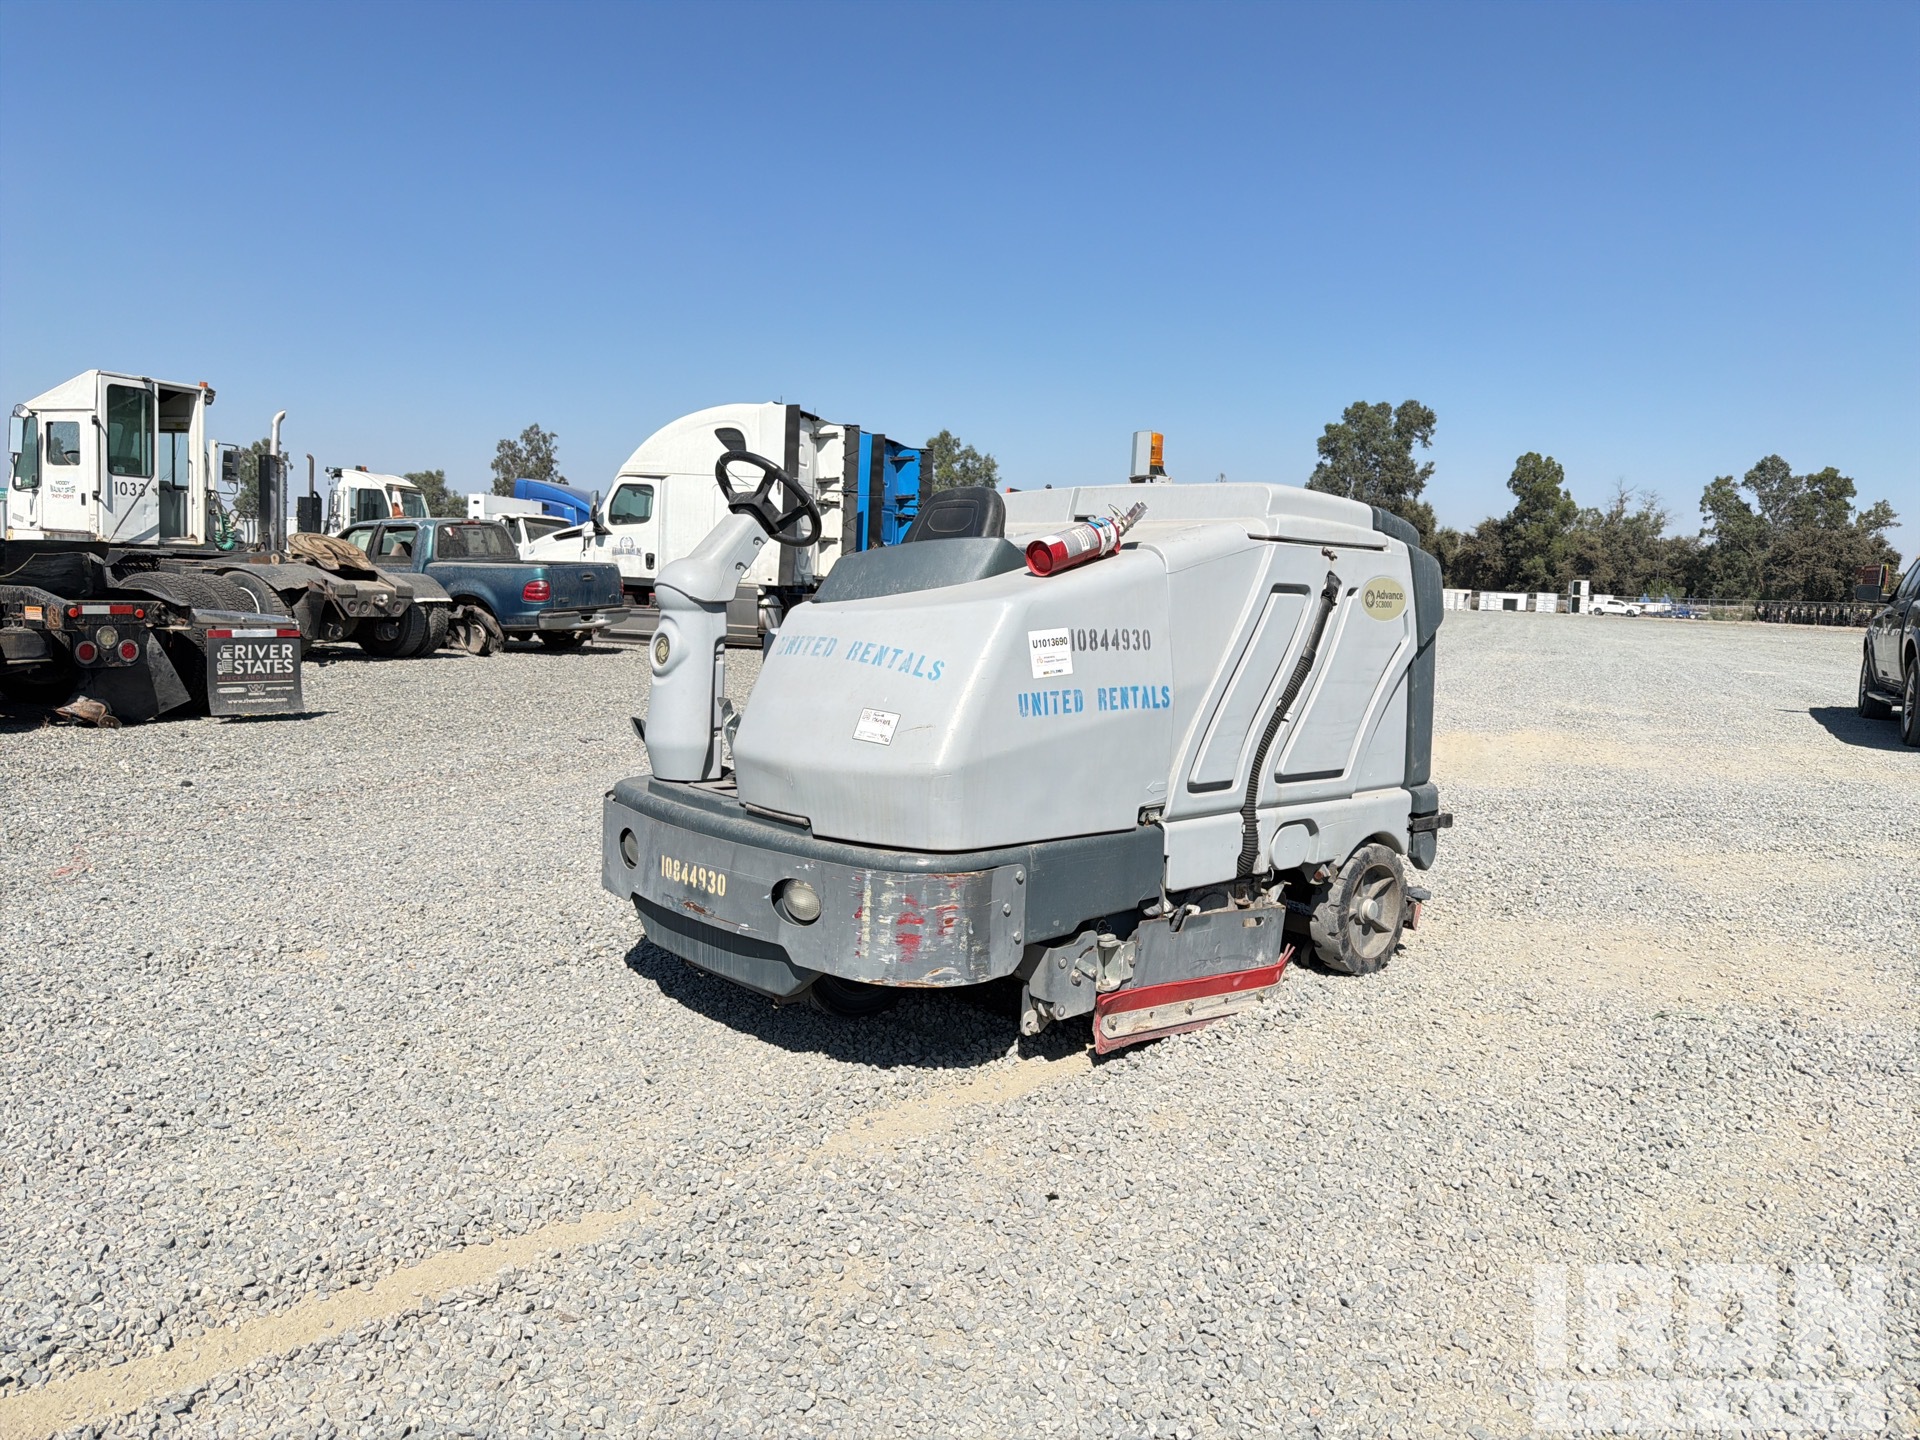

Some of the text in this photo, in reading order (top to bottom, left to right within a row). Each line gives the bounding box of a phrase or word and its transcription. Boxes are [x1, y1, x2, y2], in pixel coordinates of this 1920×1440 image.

[114, 481, 146, 497] 1033
[1376, 590, 1403, 600] Advance
[1375, 600, 1392, 608] SC8000
[1032, 636, 1068, 649] U1013690
[1070, 628, 1151, 652] 10844930
[234, 644, 293, 659] RIVER
[776, 635, 945, 681] UNITED RENTALS
[234, 659, 294, 674] STATES
[1018, 685, 1171, 718] UNITED RENTALS
[661, 854, 726, 897] 10844930
